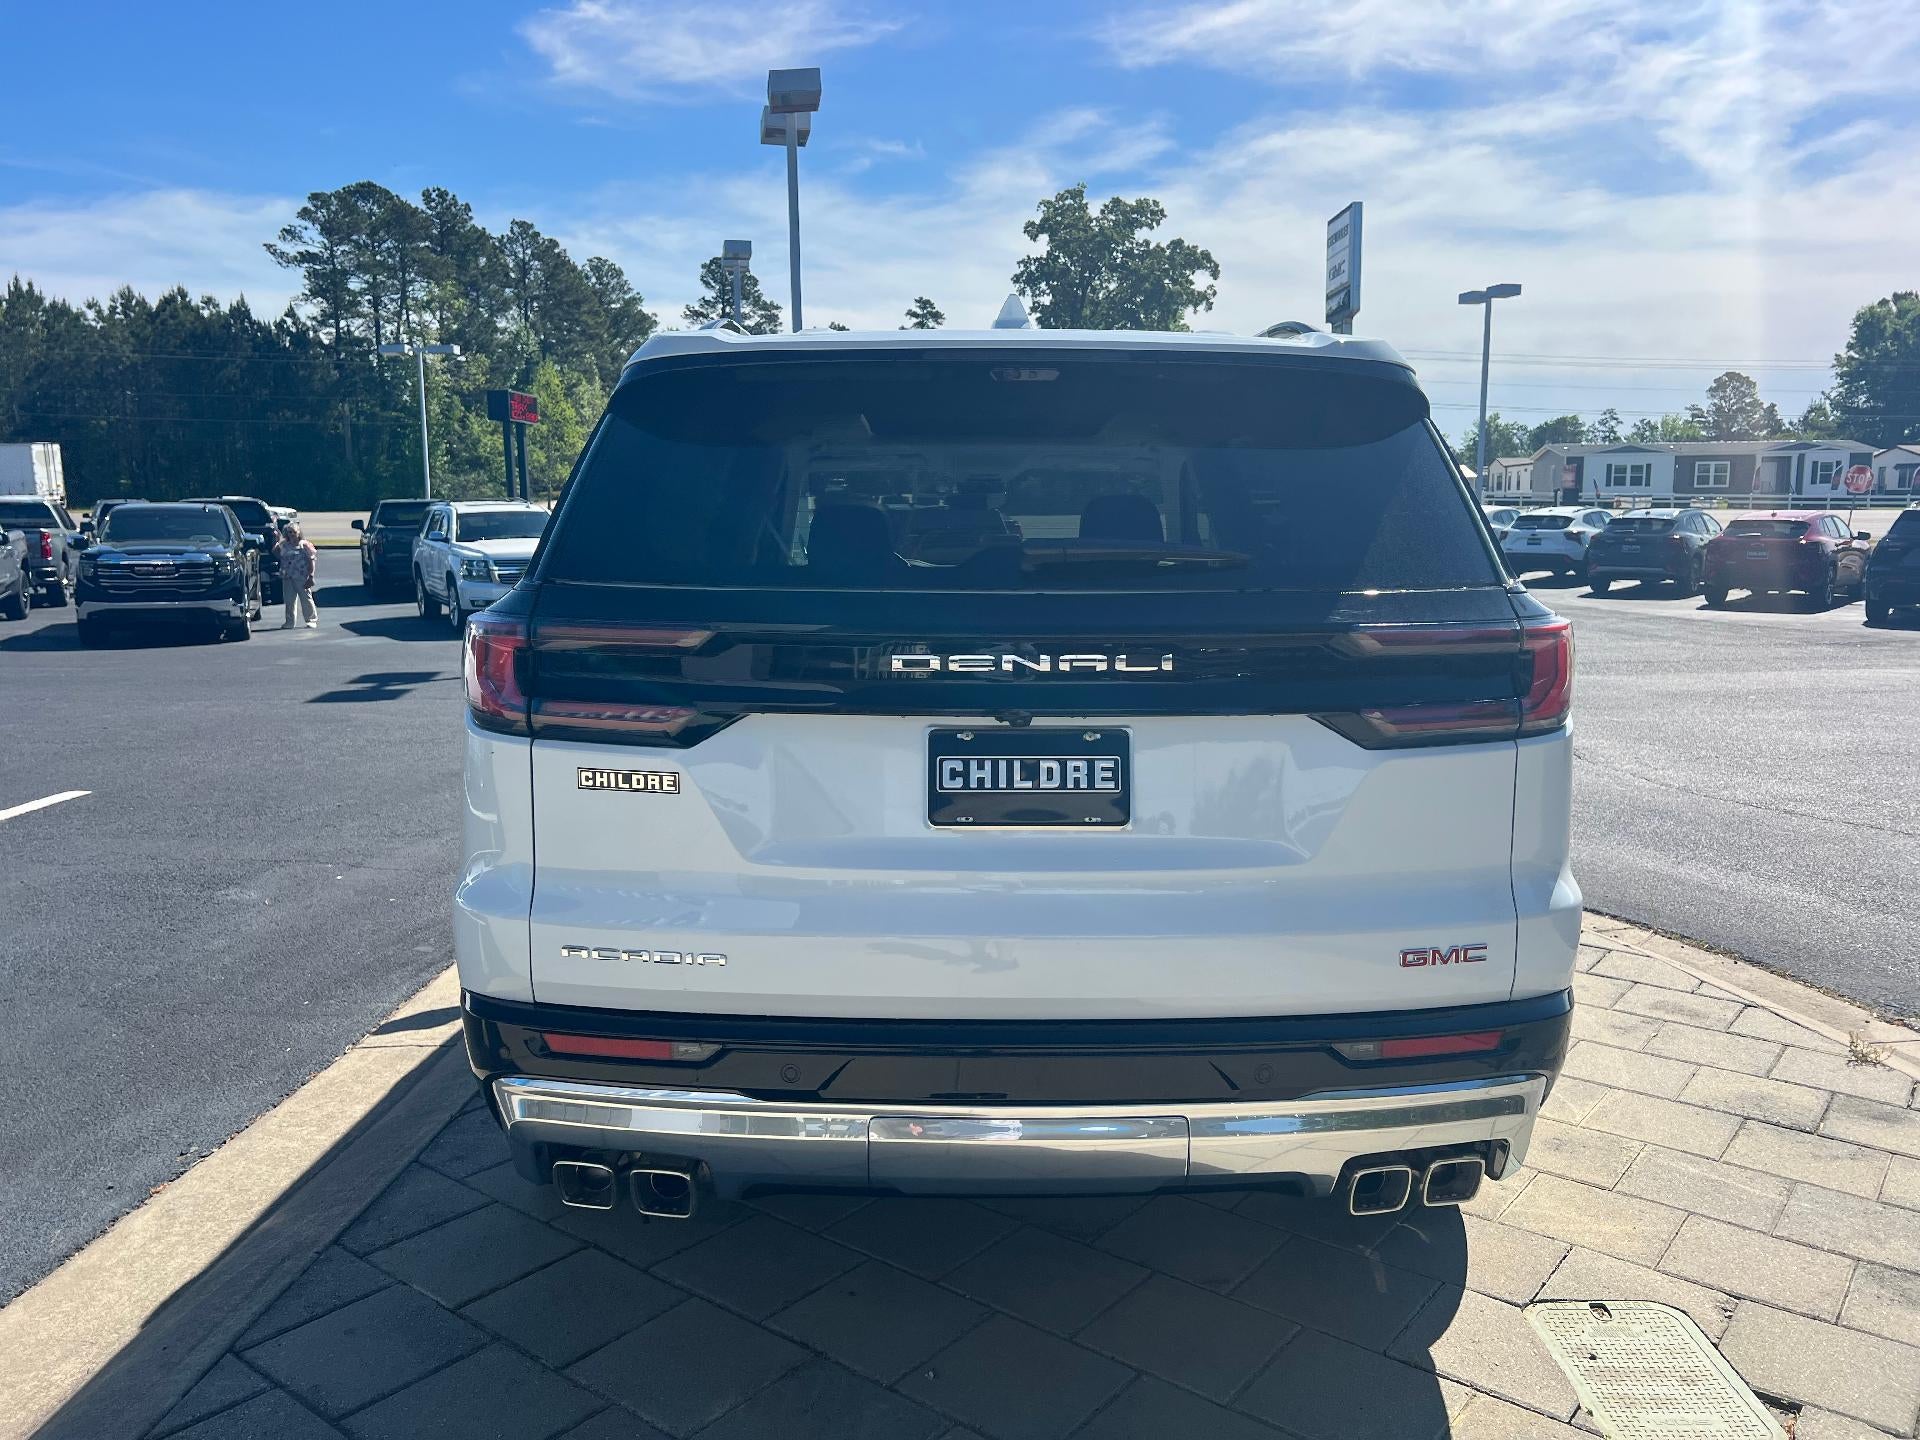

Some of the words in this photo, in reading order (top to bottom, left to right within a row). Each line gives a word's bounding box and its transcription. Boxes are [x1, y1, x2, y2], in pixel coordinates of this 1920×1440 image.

[1846, 471, 1872, 485] STOP
[891, 653, 1174, 672] DENALI
[580, 771, 677, 791] CHILDRE
[942, 759, 1116, 789] CHILDRE
[561, 944, 728, 967] ACADIA
[1399, 943, 1488, 968] GMC
